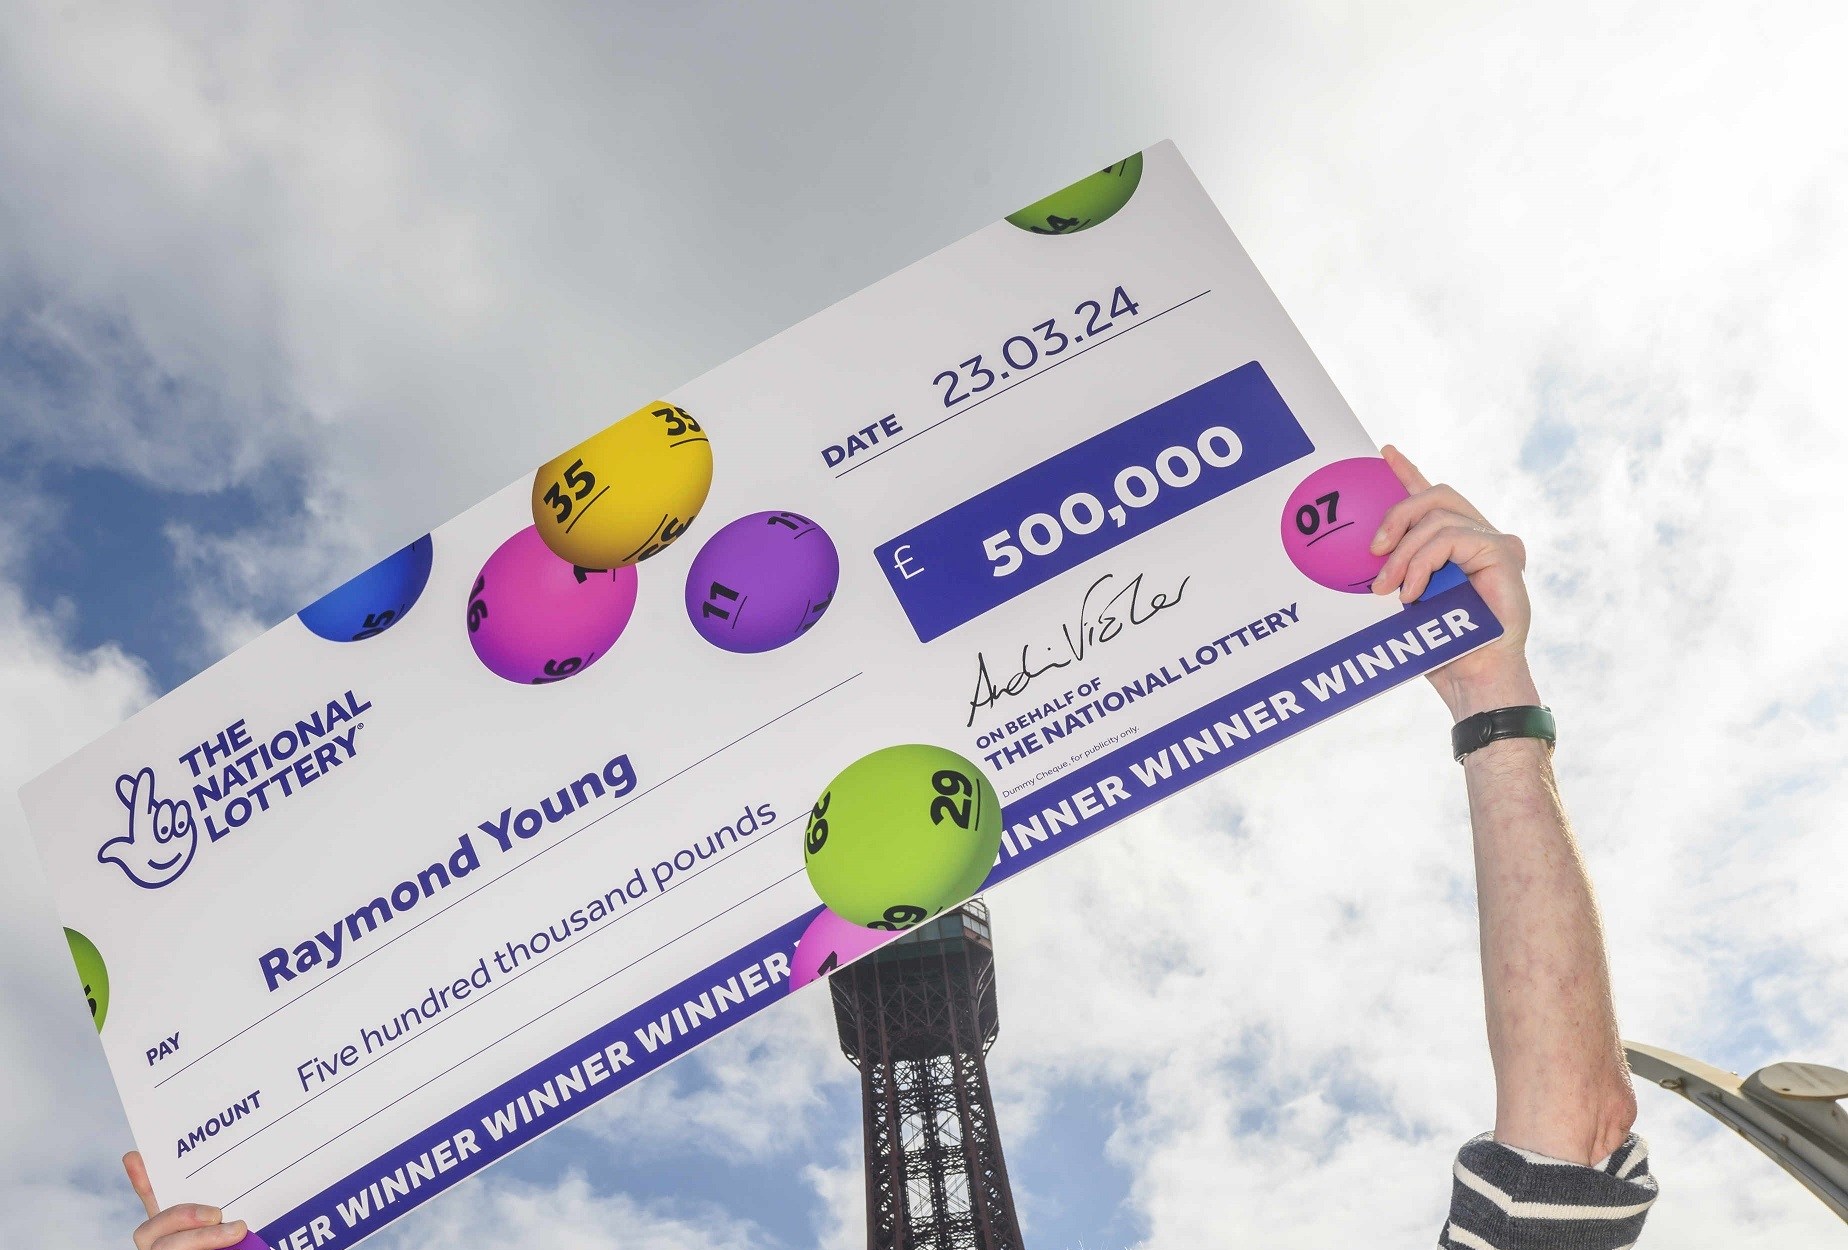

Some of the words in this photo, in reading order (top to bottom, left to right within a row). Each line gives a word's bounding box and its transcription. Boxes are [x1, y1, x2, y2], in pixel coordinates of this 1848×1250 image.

[651, 406, 702, 436] 35
[821, 413, 903, 469] DATE
[932, 285, 1141, 408] 23.03.24
[543, 458, 596, 524] 35
[893, 545, 925, 579] £
[982, 426, 1244, 577] 500,000
[1296, 490, 1340, 536] 07
[702, 581, 739, 620] 11
[975, 728, 1004, 750] ON
[1004, 690, 1075, 735] BEHALF
[1077, 677, 1102, 697] OF
[984, 732, 1044, 772] THE
[1041, 665, 1183, 745] NATIONAL
[1178, 602, 1301, 675] LOTTERY
[992, 775, 1131, 866] INNER
[1130, 690, 1304, 788] WINNER
[1302, 607, 1479, 702] WINNER
[178, 718, 253, 778] THE
[192, 690, 372, 811] NATIONAL
[204, 725, 357, 843] LOTTERY
[930, 769, 973, 830] 29
[1002, 777, 1035, 798] Dummy
[1036, 761, 1071, 781] Cheque,
[1070, 753, 1083, 764] for
[1084, 735, 1119, 758] publicity
[1119, 725, 1140, 738] only.
[145, 1031, 182, 1068] PAY
[258, 834, 481, 992] Raymond
[478, 752, 639, 853] Young
[174, 1089, 264, 1160] AMOUNT
[296, 1040, 359, 1093] Five
[361, 958, 492, 1056] hundred
[494, 868, 650, 975] thousand
[651, 800, 777, 893] pounds
[336, 1127, 481, 1228] WINNER
[481, 1040, 635, 1141] WINNER
[635, 952, 791, 1053] WINNER
